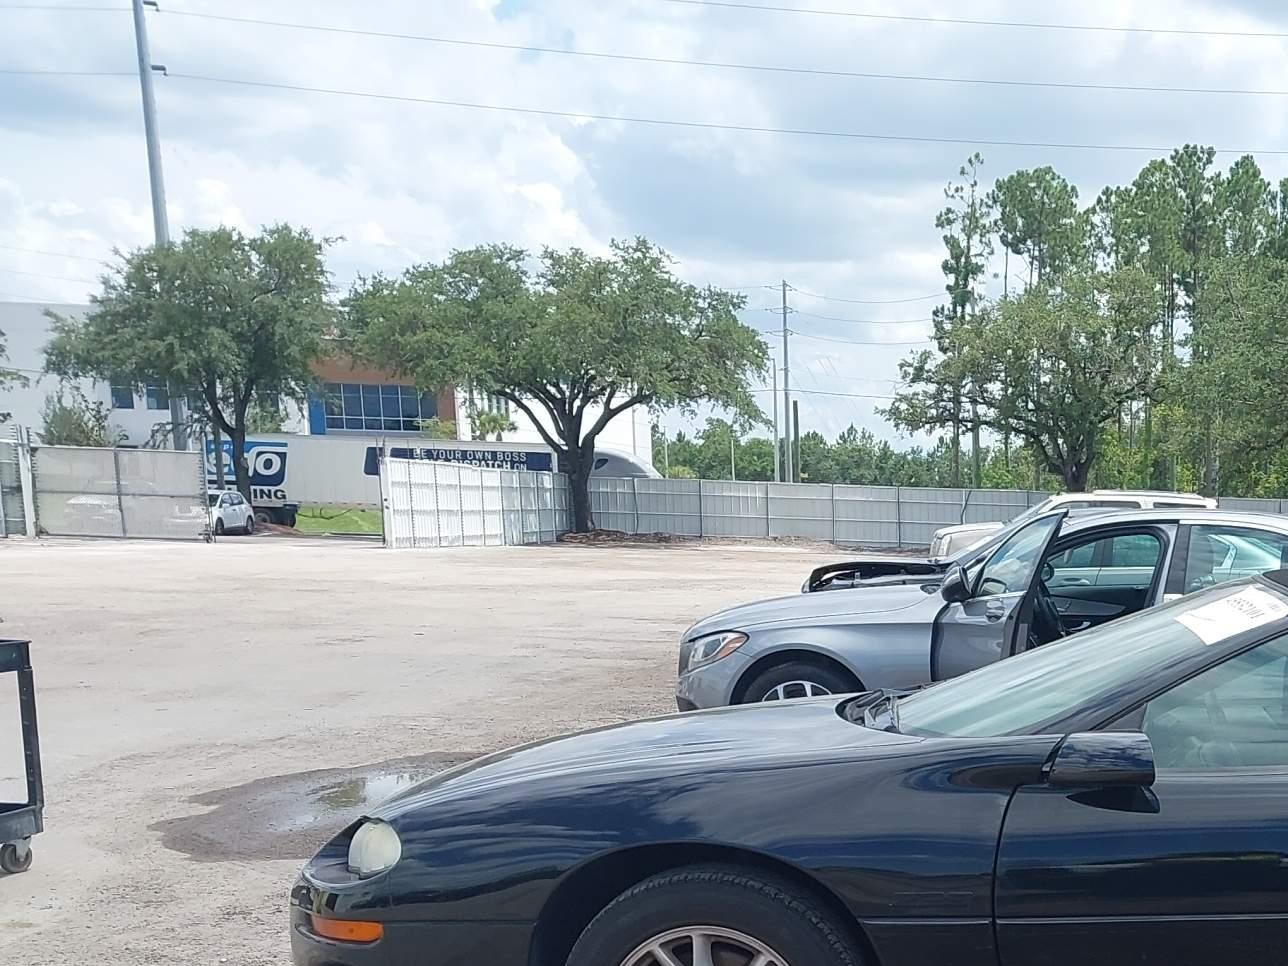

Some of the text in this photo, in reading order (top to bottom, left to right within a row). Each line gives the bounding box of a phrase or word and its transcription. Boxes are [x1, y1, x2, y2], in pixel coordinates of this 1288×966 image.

[432, 450, 461, 459] YOUR
[467, 451, 491, 460] OWN
[497, 452, 526, 461] BOSS
